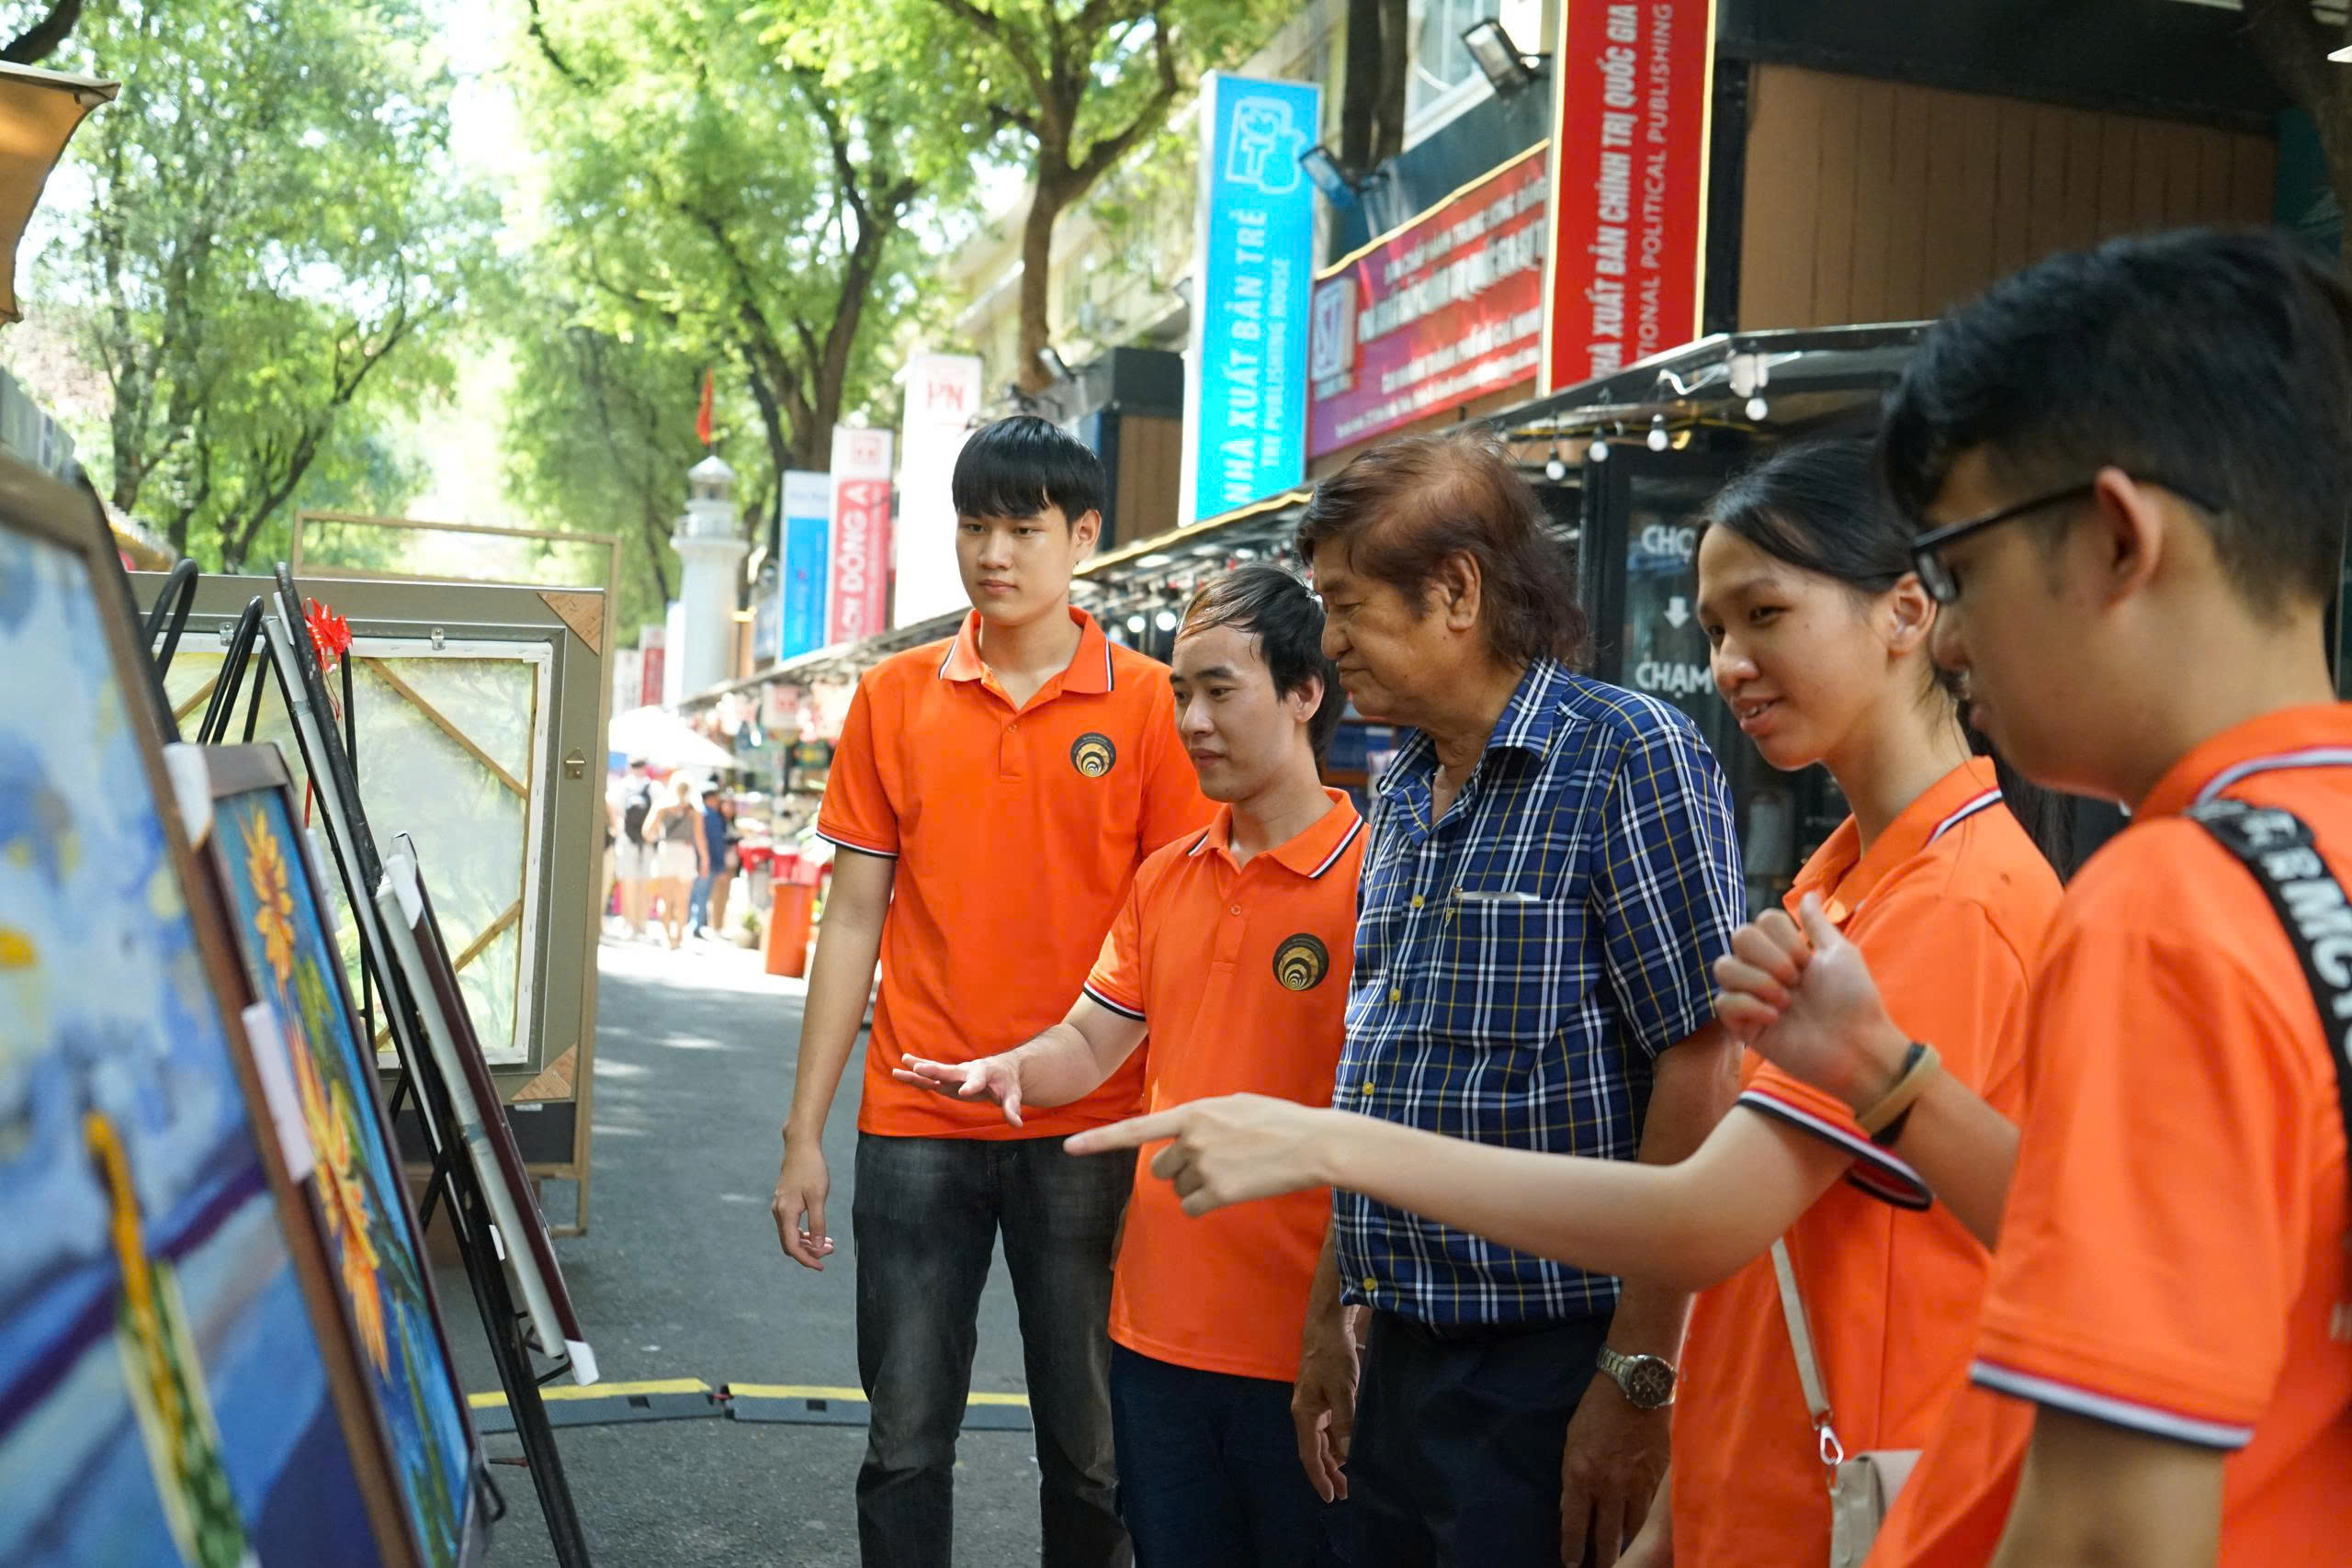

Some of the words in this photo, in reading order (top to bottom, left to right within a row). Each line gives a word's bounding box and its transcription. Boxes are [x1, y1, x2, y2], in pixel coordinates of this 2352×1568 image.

[1606, 5, 1639, 43] GIA
[1596, 46, 1639, 108] QUỐC
[1647, 4, 1674, 144] PUBLISHING
[1601, 112, 1639, 148] TRỊ
[1594, 153, 1632, 223] CHÍNH
[1640, 149, 1667, 269] POLITICAL
[1587, 226, 1629, 276] BẢN
[1223, 276, 1265, 341] BẢN
[1585, 278, 1625, 339] XUẤT
[1635, 276, 1661, 359] TIONAL
[1221, 348, 1260, 430] XUẤT
[1219, 438, 1256, 504] NHÀ
[1640, 524, 1696, 564] CHỌ
[1634, 660, 1713, 699] CHẠM
